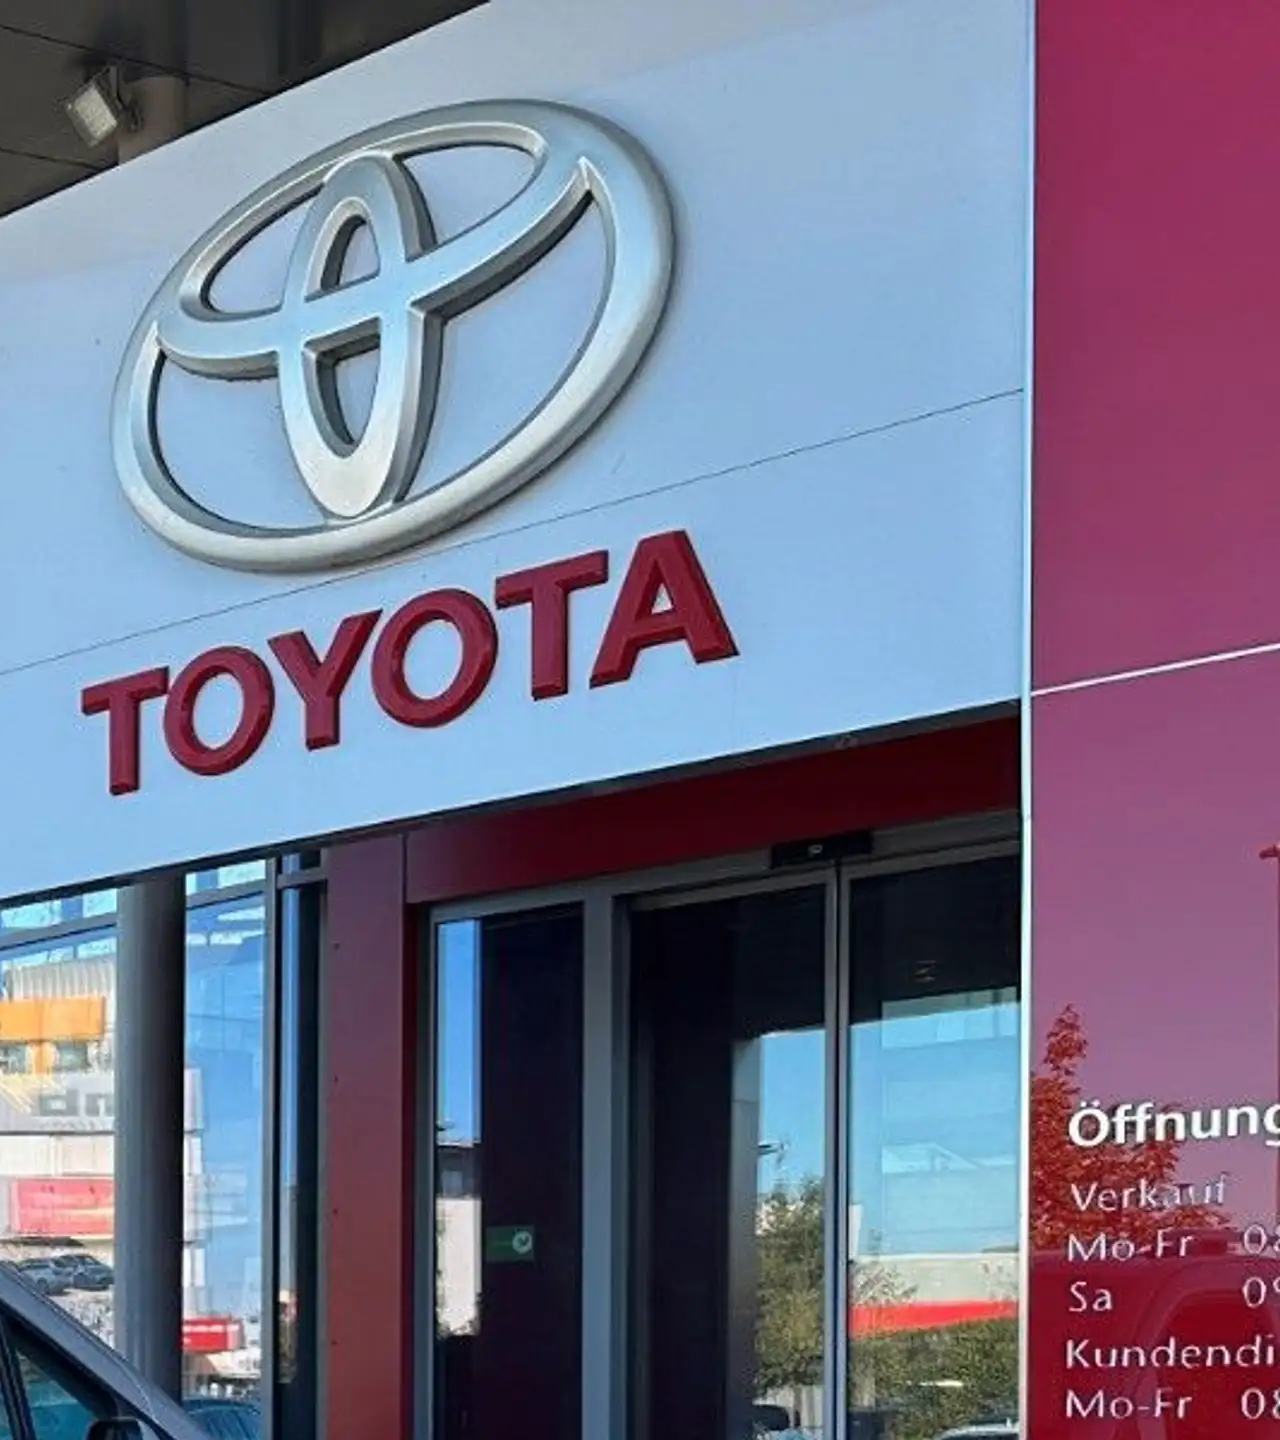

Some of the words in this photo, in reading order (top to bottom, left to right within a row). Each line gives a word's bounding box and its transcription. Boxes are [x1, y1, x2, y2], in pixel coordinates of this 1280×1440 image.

[81, 529, 740, 796] TOYOTA
[1071, 1172, 1229, 1212] Verkauf
[1068, 1227, 1193, 1262] Mo-Fr
[1068, 1280, 1113, 1312] Sa
[1065, 1334, 1275, 1369] Kundendi
[1065, 1388, 1193, 1419] Mo-Fr
